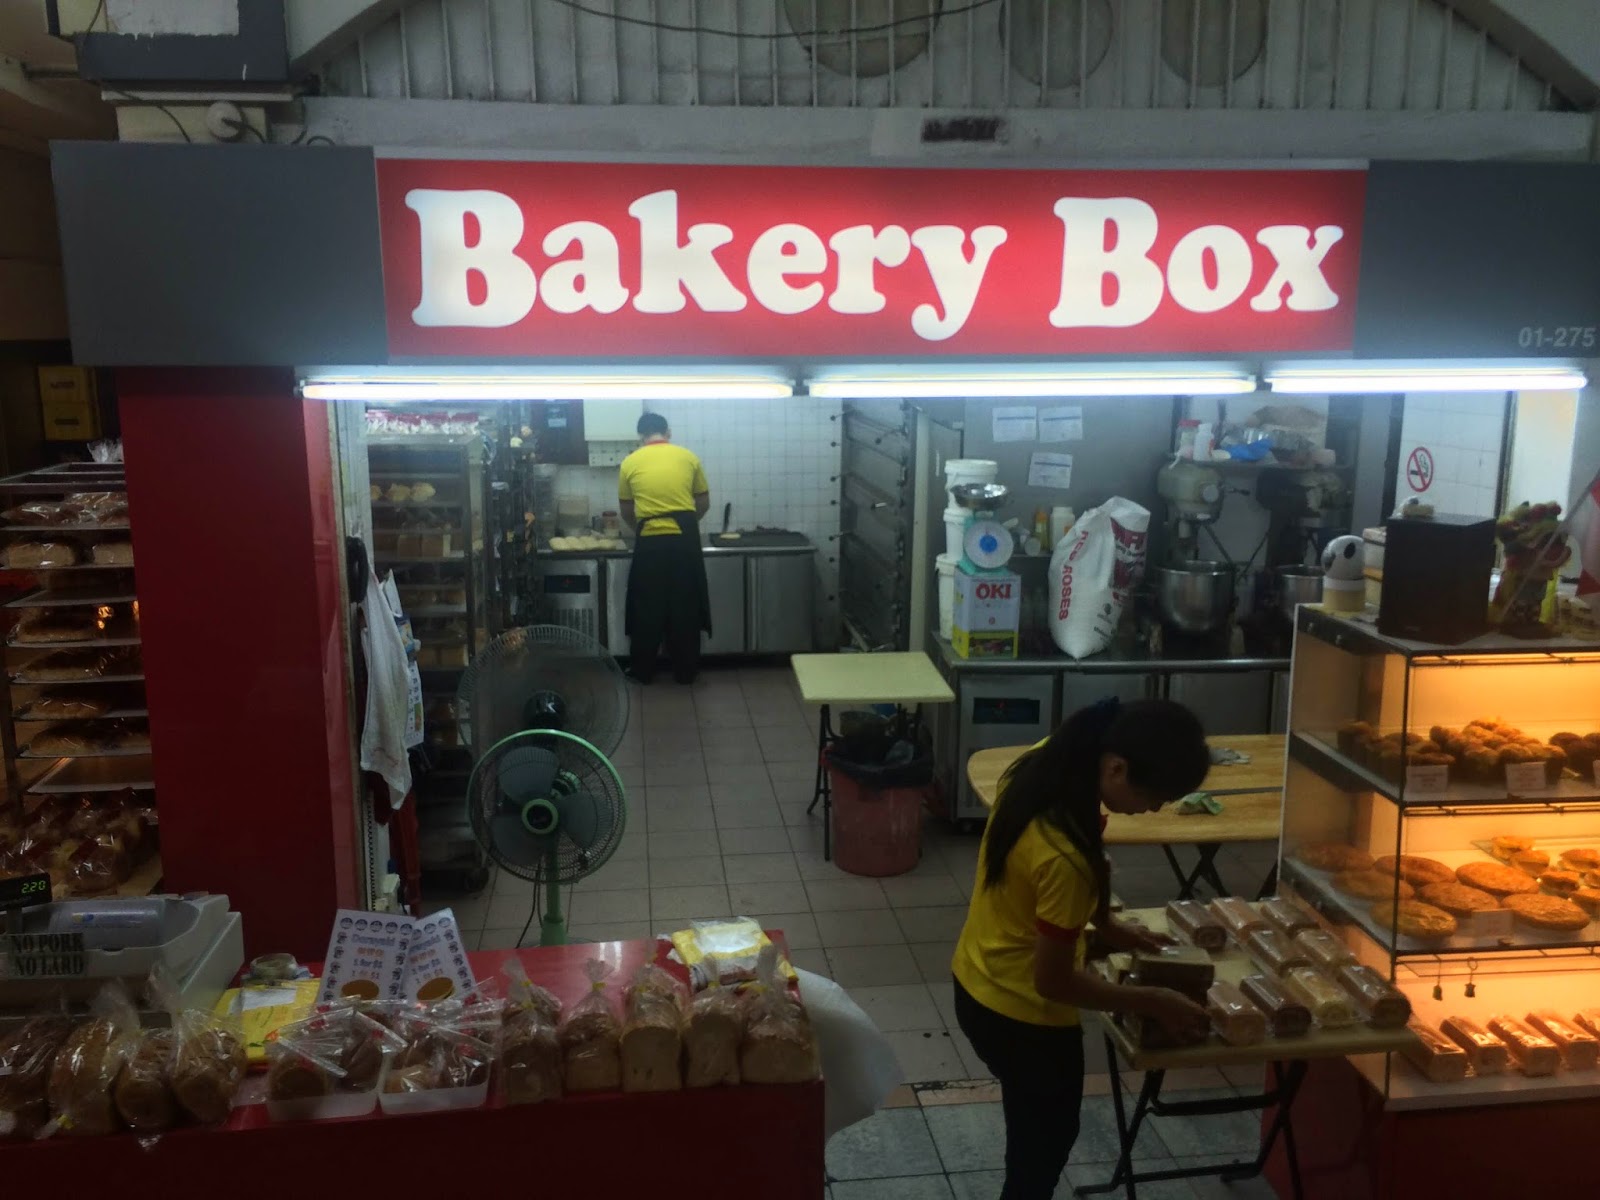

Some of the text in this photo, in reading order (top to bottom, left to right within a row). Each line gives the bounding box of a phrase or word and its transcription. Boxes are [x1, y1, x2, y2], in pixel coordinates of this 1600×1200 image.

[405, 189, 1343, 341] Bakery Box
[1518, 326, 1596, 348] 01-275
[975, 583, 1012, 600] OKI
[1058, 565, 1073, 621] ROSES
